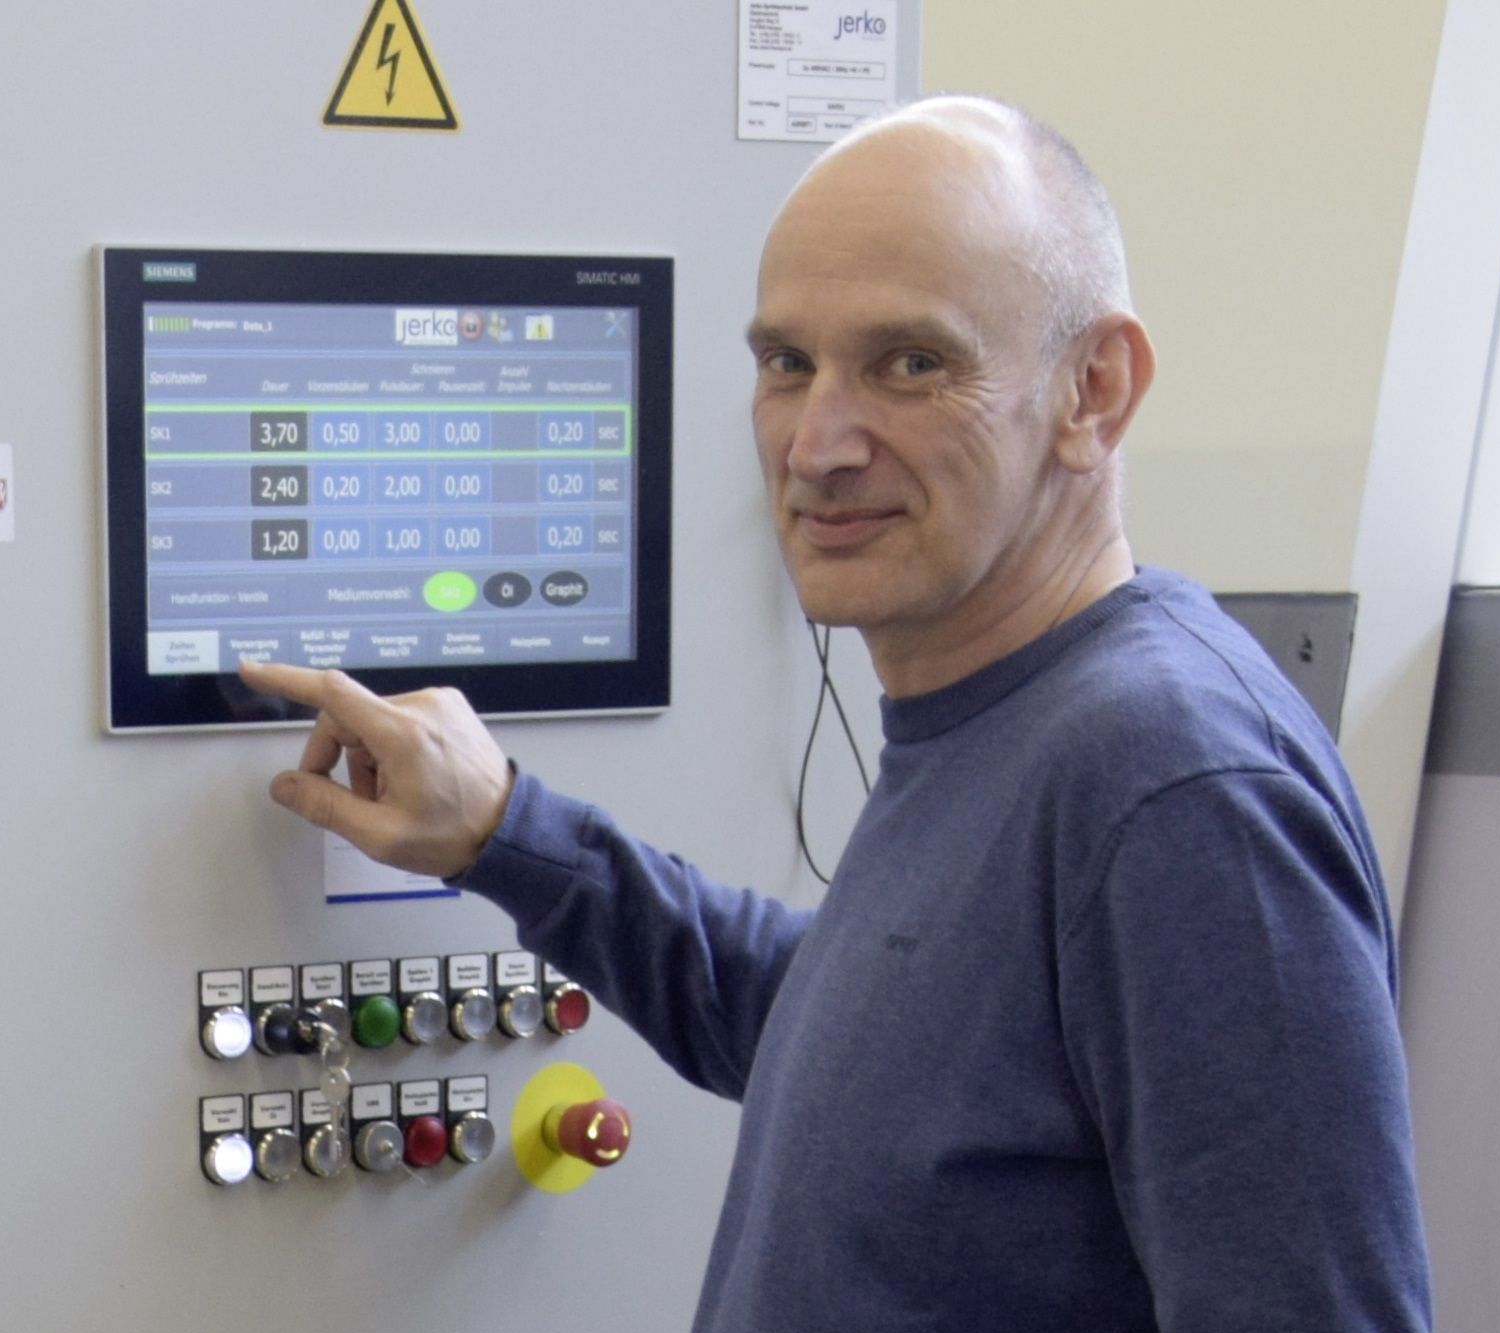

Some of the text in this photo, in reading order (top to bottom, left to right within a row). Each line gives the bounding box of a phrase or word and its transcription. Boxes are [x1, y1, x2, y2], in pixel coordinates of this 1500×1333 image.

[834, 10, 886, 40] jerko
[145, 265, 193, 278] SIEMENS
[576, 271, 640, 285] SIMATIC HMI
[400, 311, 457, 338] jerko
[149, 371, 207, 385] Sprühzeiten
[150, 422, 619, 448] SK1 3,70 0,50 3,00 0,00 0,20 sec
[151, 474, 619, 501] SK2 2,40 0,20 2,00 0,00 0,20 sec
[151, 526, 619, 555] SK3 1,20 0,00 1,00 0,00 0,20 sec
[545, 583, 584, 598] Graphit
